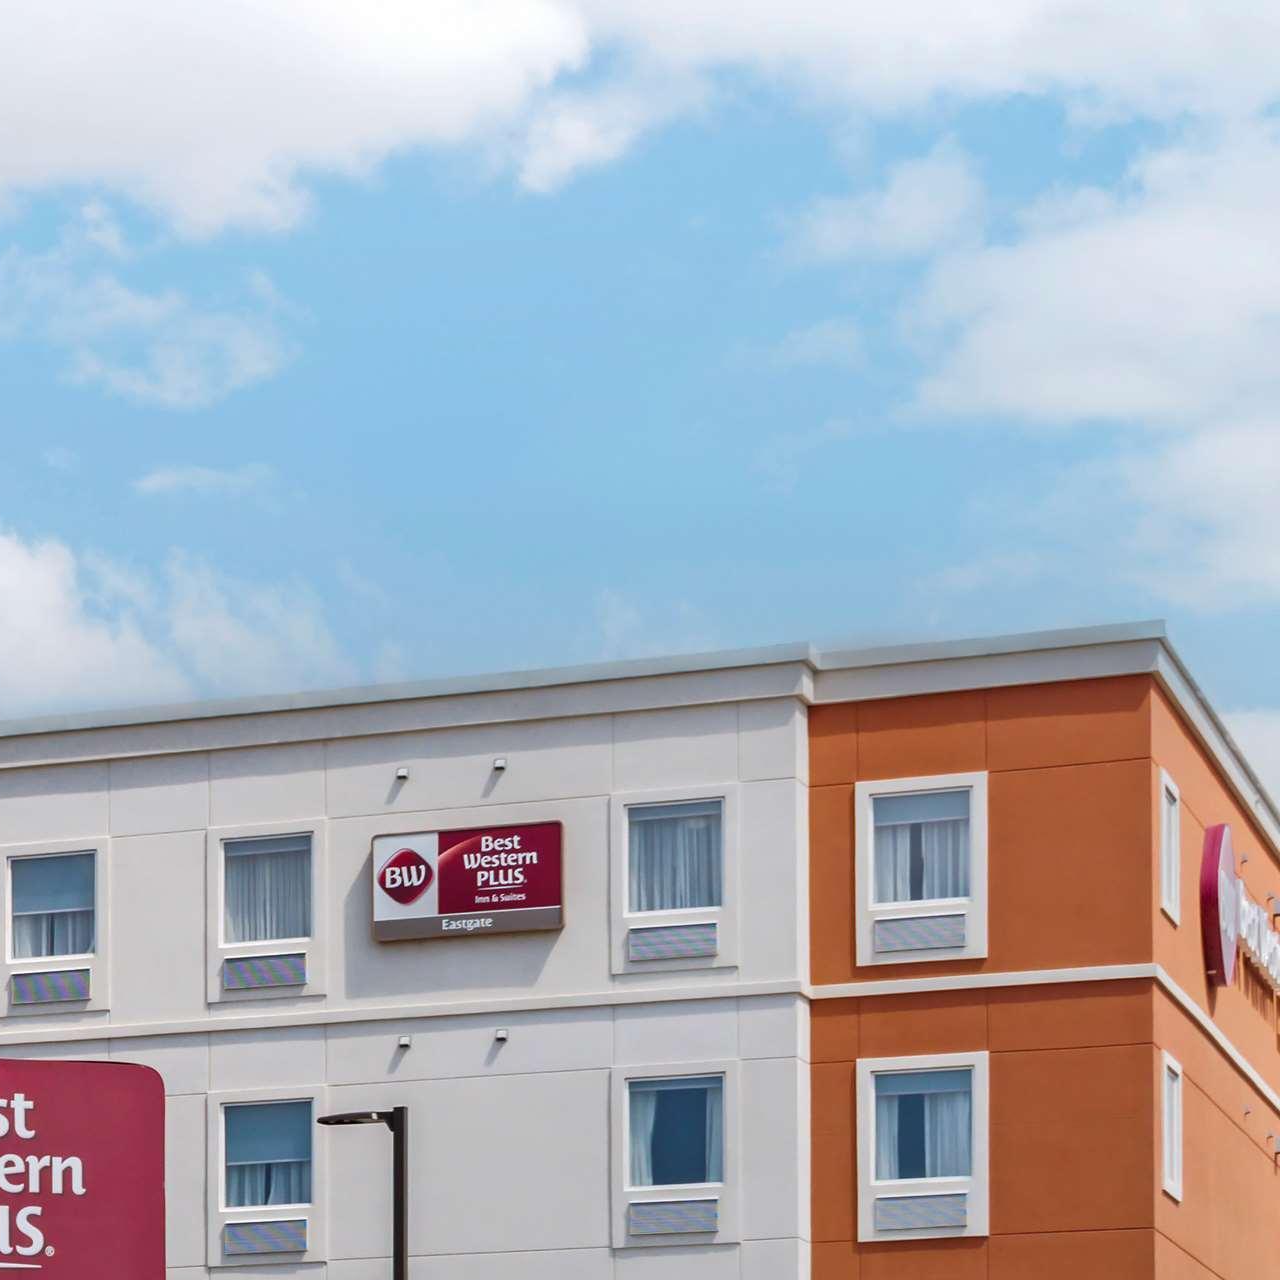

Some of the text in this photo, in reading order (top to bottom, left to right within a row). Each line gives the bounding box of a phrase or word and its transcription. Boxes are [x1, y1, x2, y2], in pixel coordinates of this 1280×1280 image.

[481, 835, 521, 852] Best
[463, 852, 538, 870] Western
[384, 864, 426, 889] BW
[442, 917, 493, 931] Eastgate
